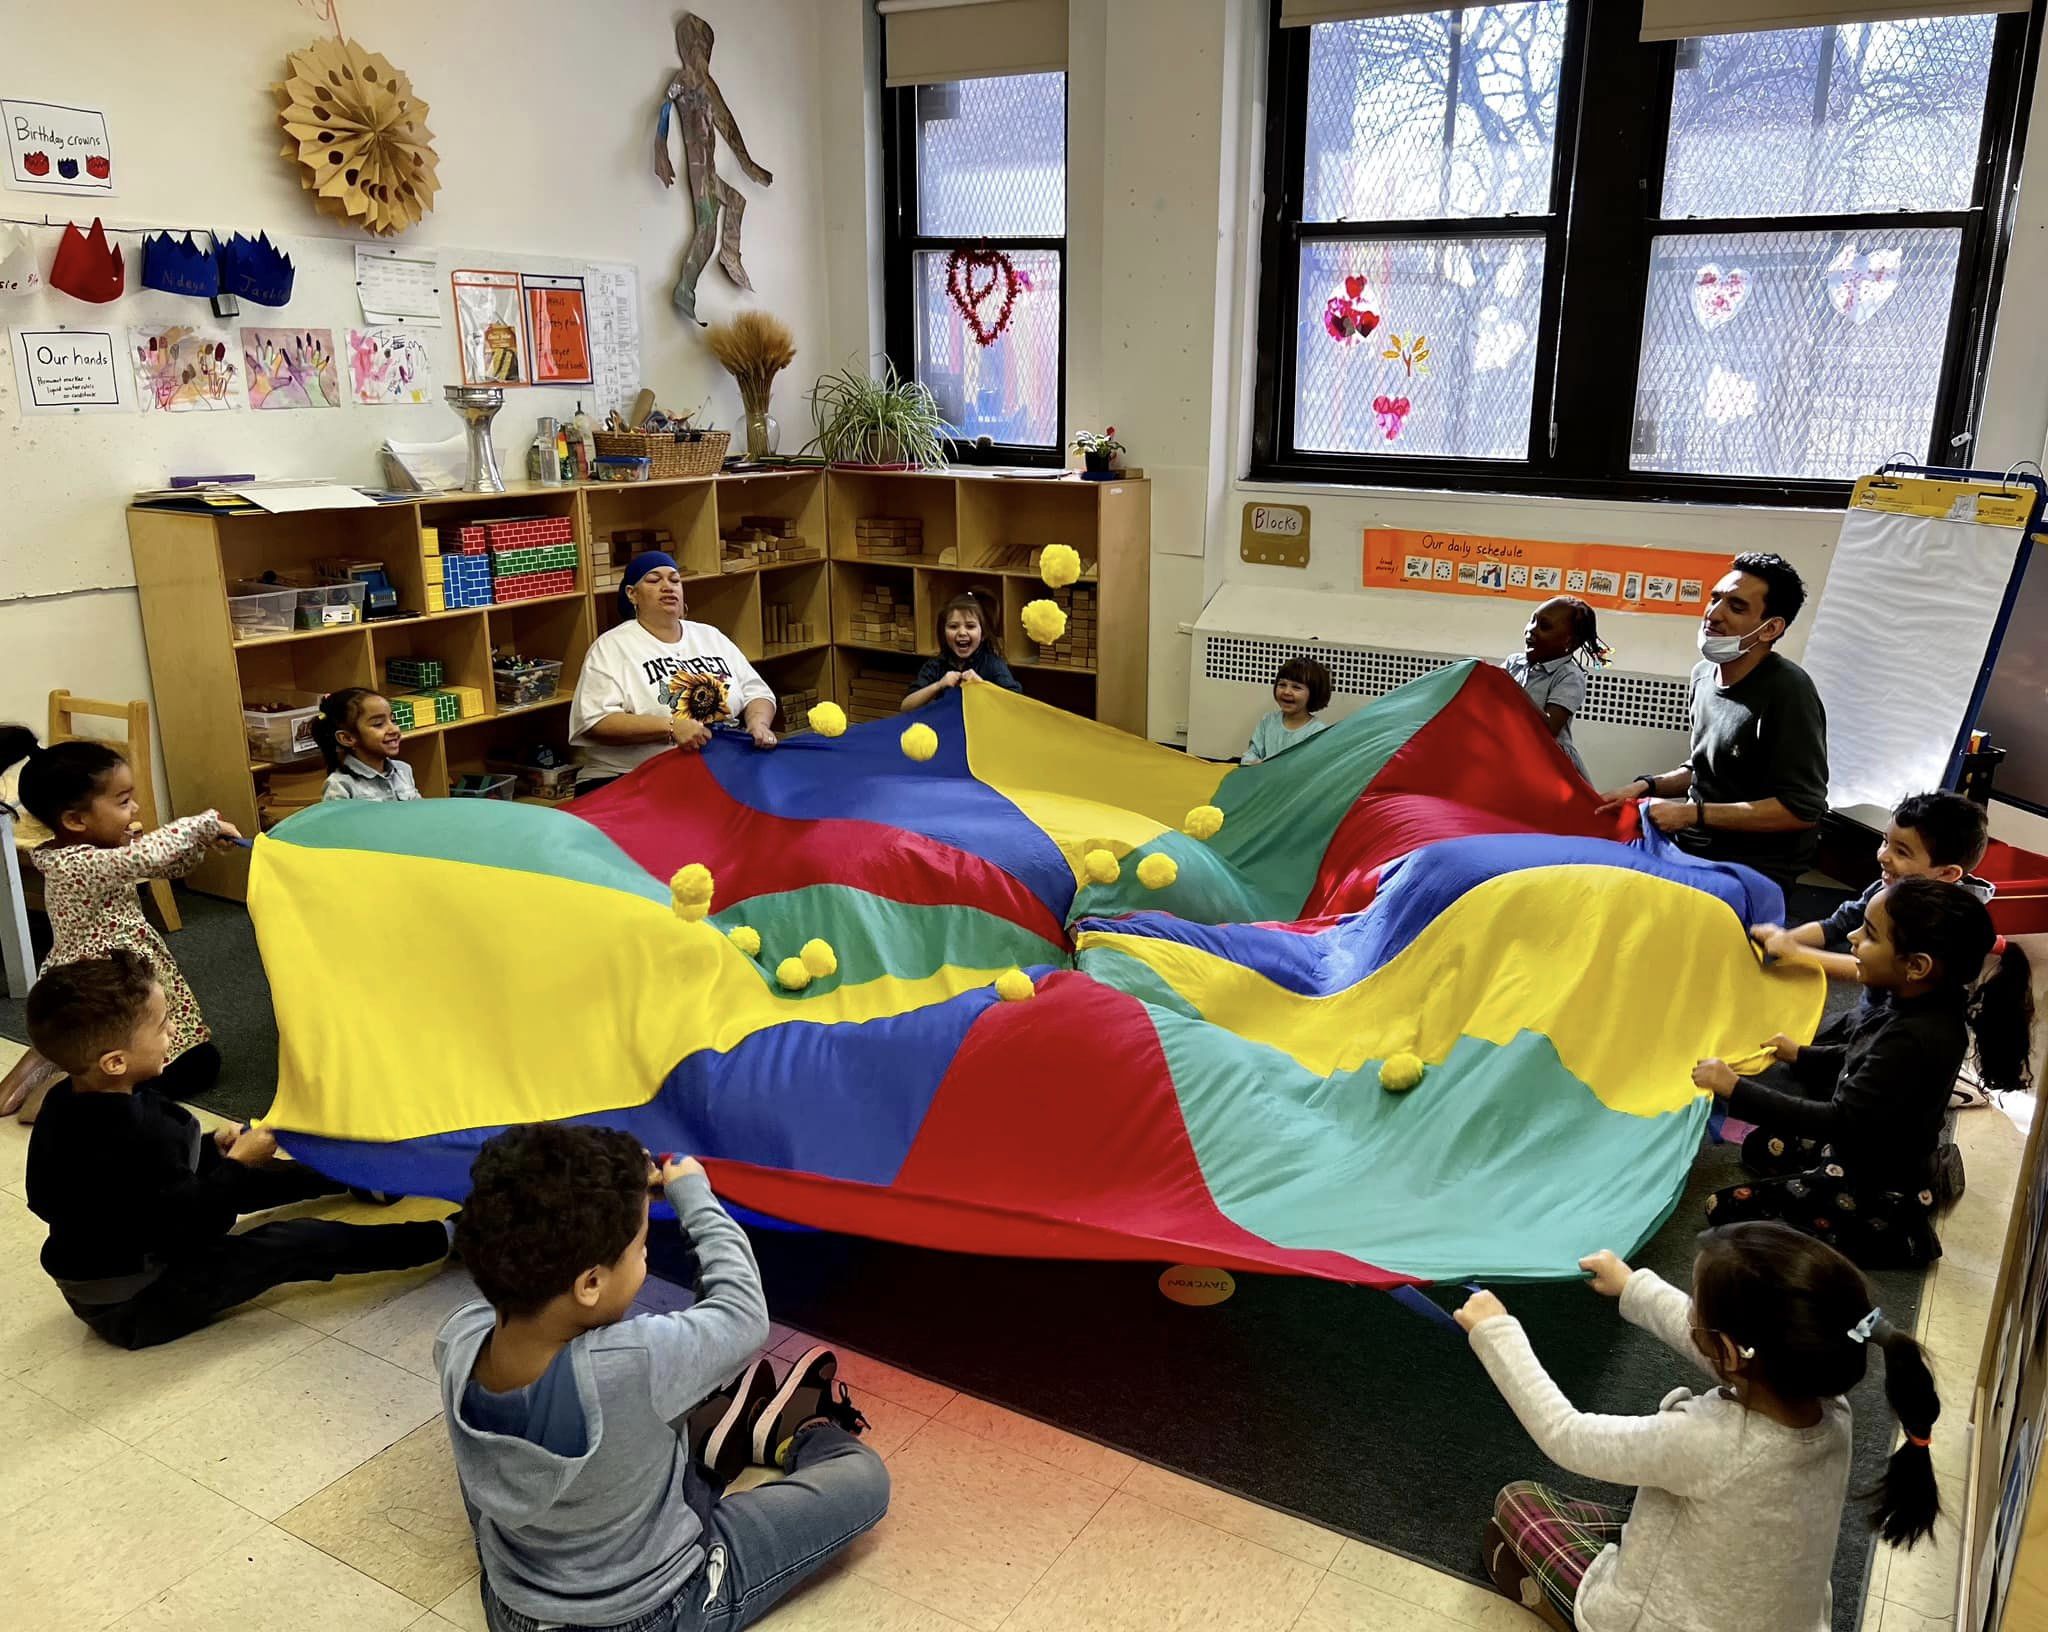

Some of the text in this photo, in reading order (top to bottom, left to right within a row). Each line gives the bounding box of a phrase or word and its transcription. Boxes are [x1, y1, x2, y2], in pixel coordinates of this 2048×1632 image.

[15, 116, 101, 150] Birthday crowns
[37, 346, 108, 366] Our hands
[1255, 508, 1297, 531] Blocks
[1422, 534, 1523, 559] Our daily schedule
